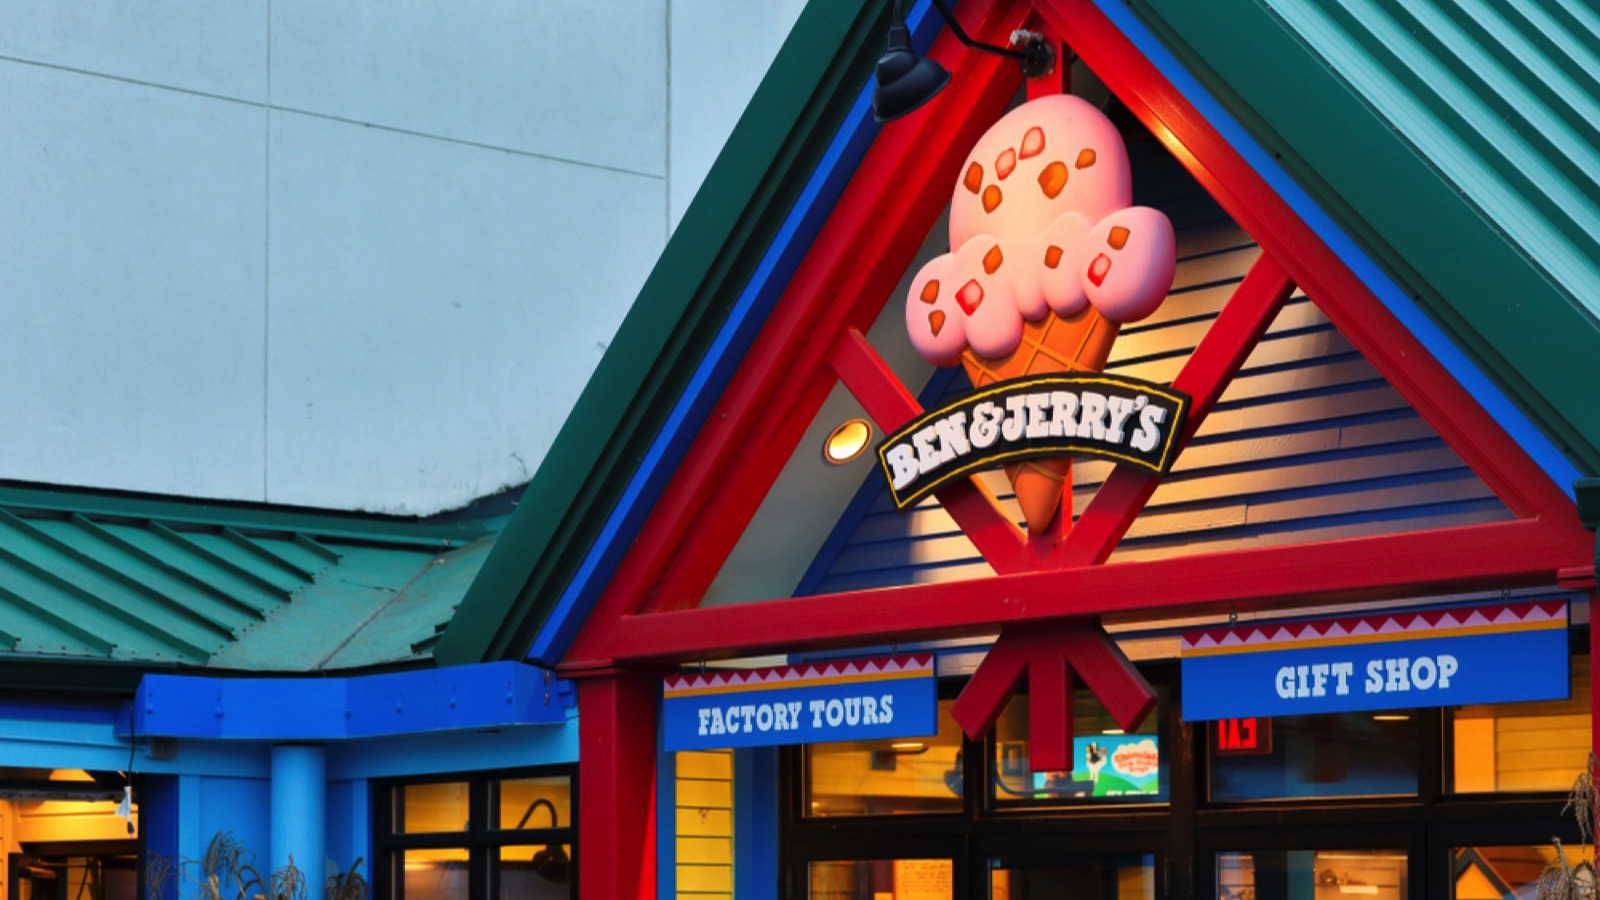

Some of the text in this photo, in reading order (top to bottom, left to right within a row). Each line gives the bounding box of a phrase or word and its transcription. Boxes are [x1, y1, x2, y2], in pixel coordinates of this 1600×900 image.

[1275, 654, 1459, 699] GIFT SHOP
[698, 694, 893, 736] FACTORY TOURS
